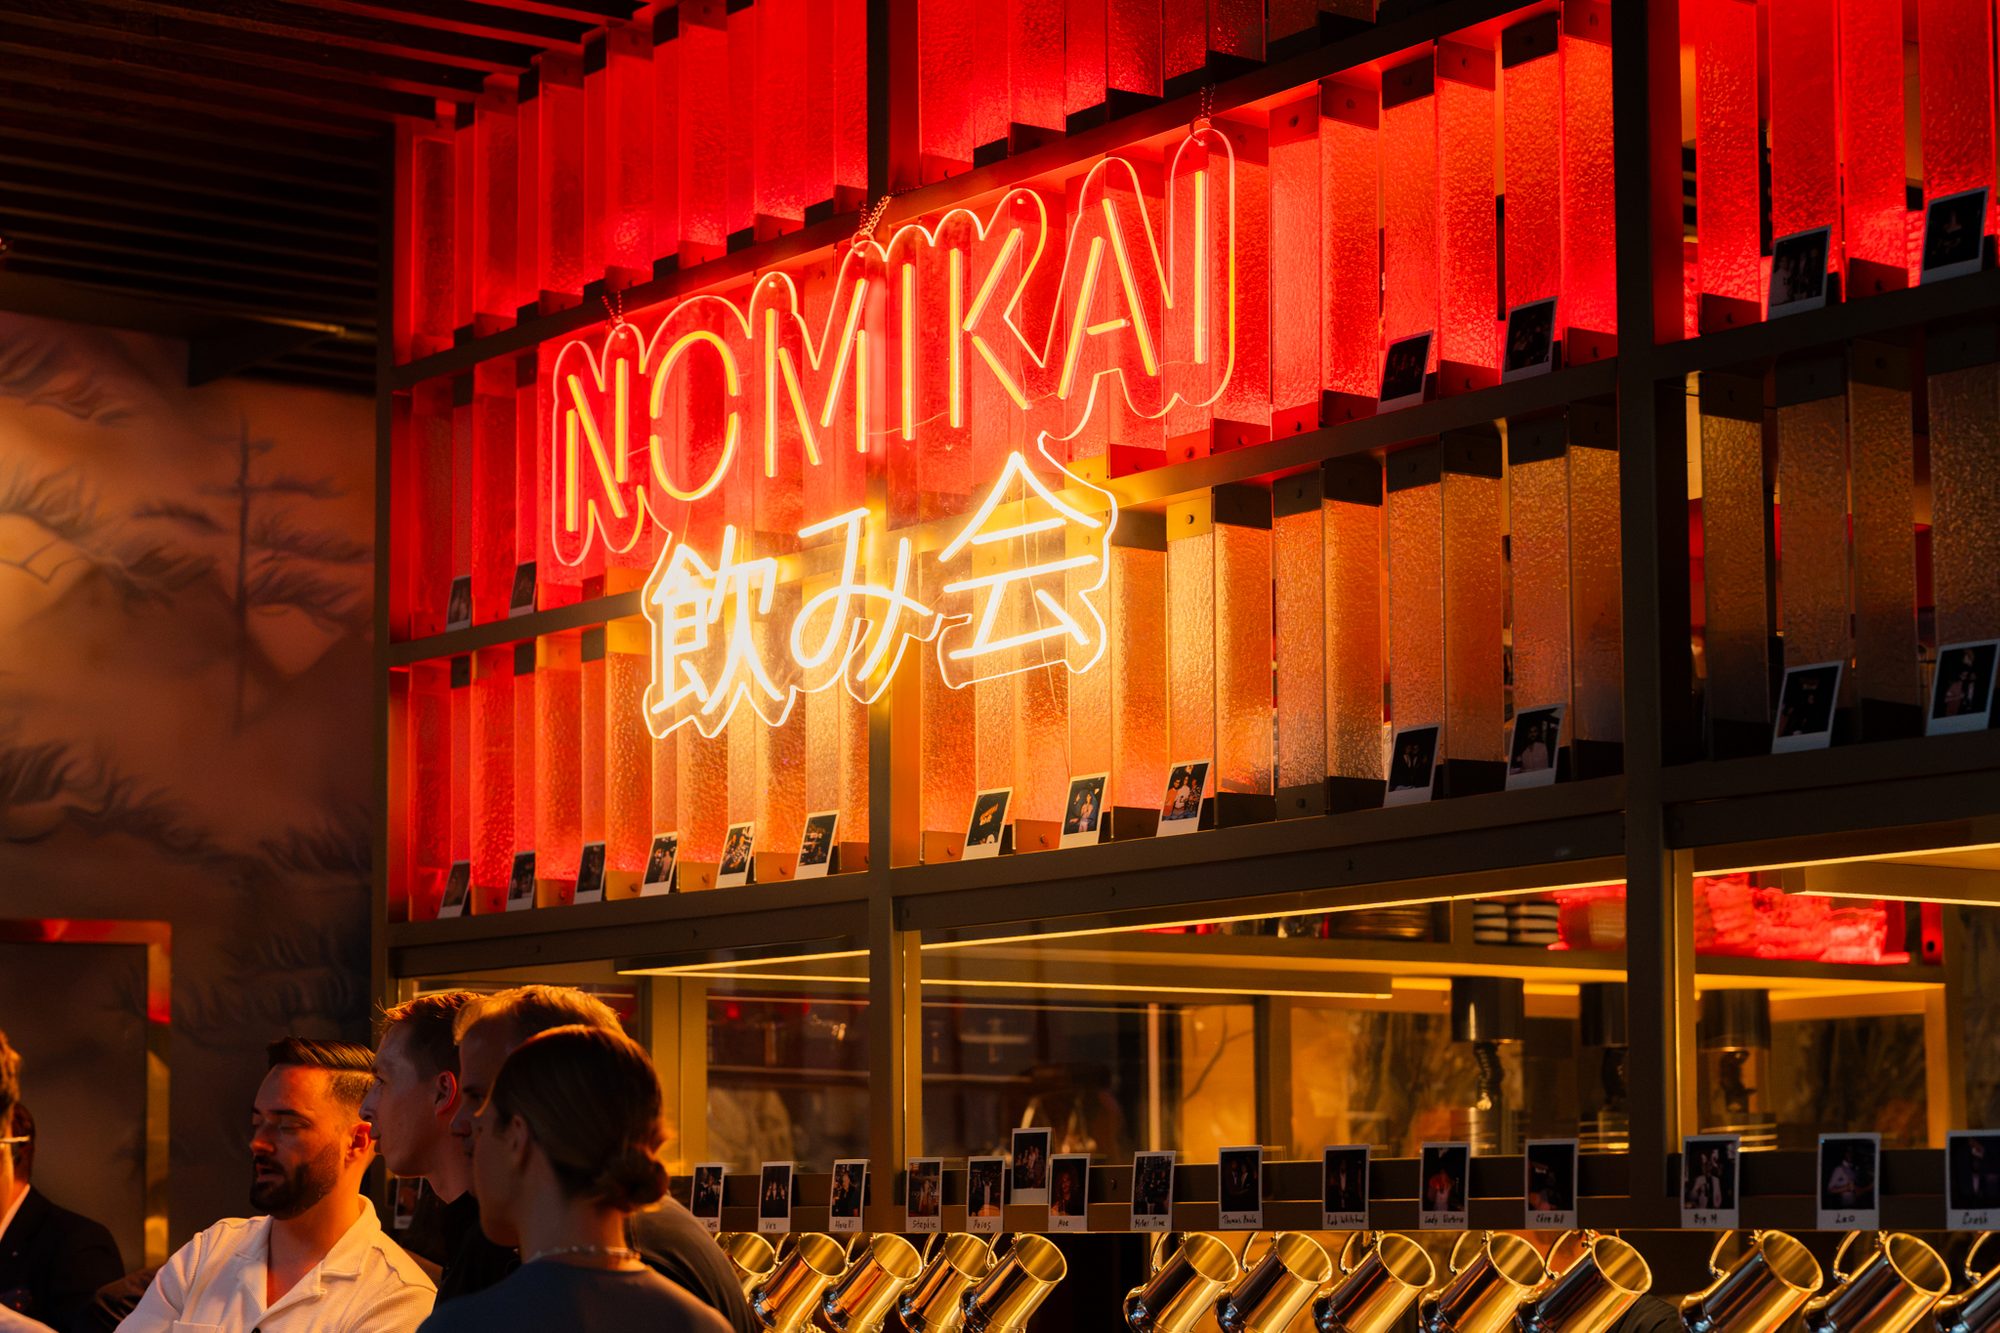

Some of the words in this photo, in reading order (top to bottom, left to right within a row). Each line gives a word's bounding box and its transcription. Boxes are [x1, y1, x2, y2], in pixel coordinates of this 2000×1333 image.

[566, 170, 1208, 533] NOMIKAI
[651, 450, 1104, 715] 飲み会
